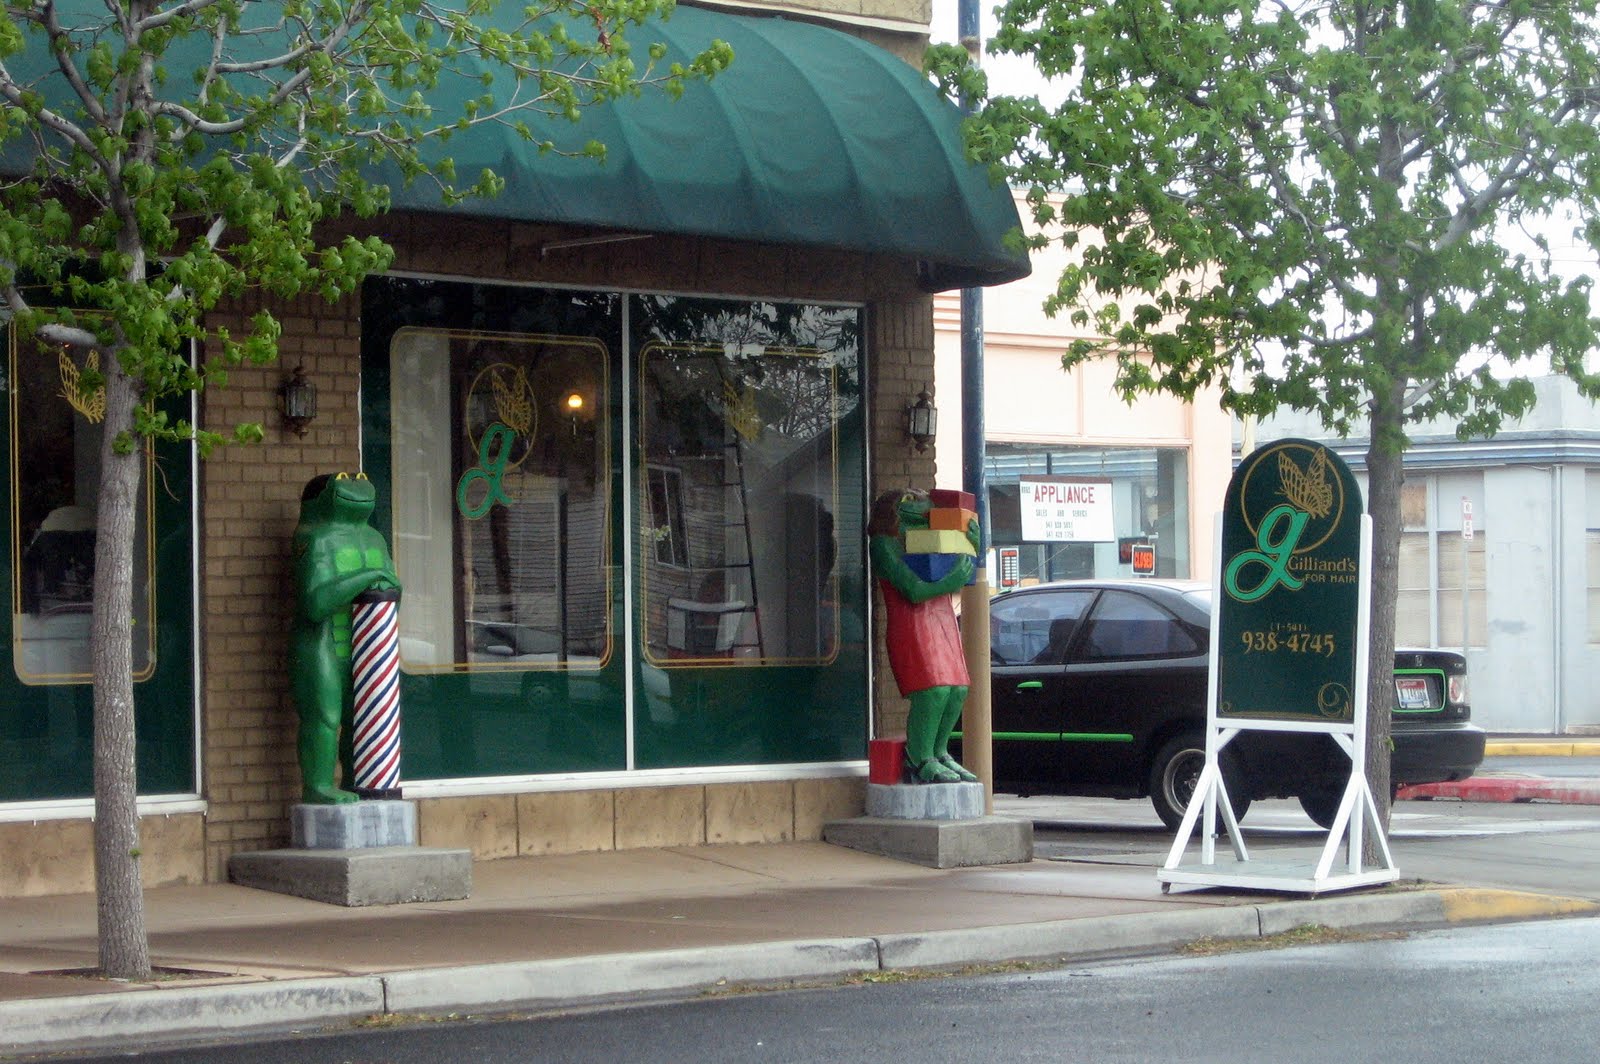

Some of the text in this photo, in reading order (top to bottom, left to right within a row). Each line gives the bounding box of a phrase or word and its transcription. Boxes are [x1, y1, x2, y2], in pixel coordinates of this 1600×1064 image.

[1034, 485, 1095, 504] APPLIANCE
[1133, 551, 1153, 569] CLOSED
[1305, 573, 1356, 583] FOR HAIR
[1242, 631, 1335, 658] 938-4745
